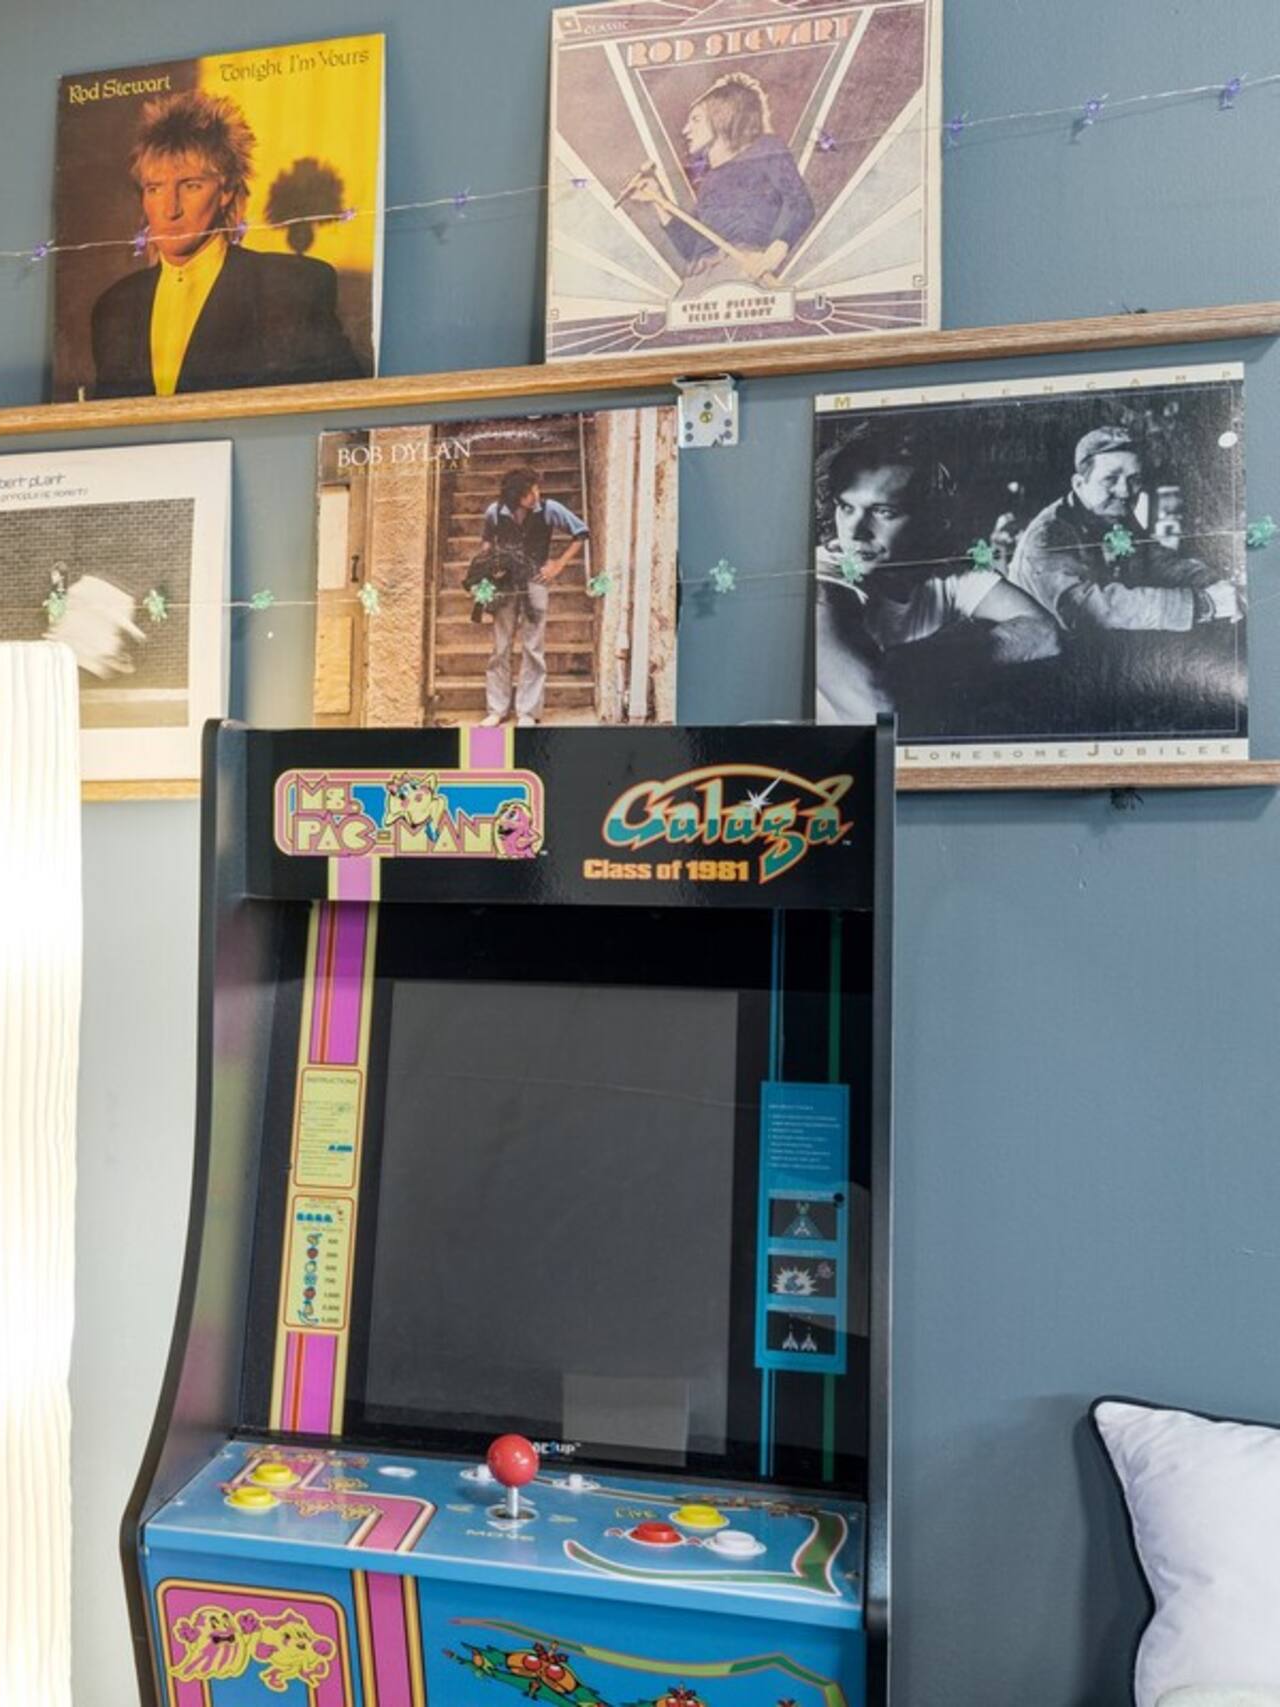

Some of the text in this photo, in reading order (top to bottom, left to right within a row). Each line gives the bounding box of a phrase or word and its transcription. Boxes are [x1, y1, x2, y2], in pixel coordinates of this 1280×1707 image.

[627, 15, 853, 67] ROD STEWART
[220, 50, 370, 82] Tonight I'm Yours
[68, 75, 171, 104] Rod Stewart
[338, 439, 471, 467] BOB DYLAN
[293, 808, 498, 857] PAC-MAN
[603, 764, 854, 885] Galaga
[583, 858, 750, 882] Class of 1981
